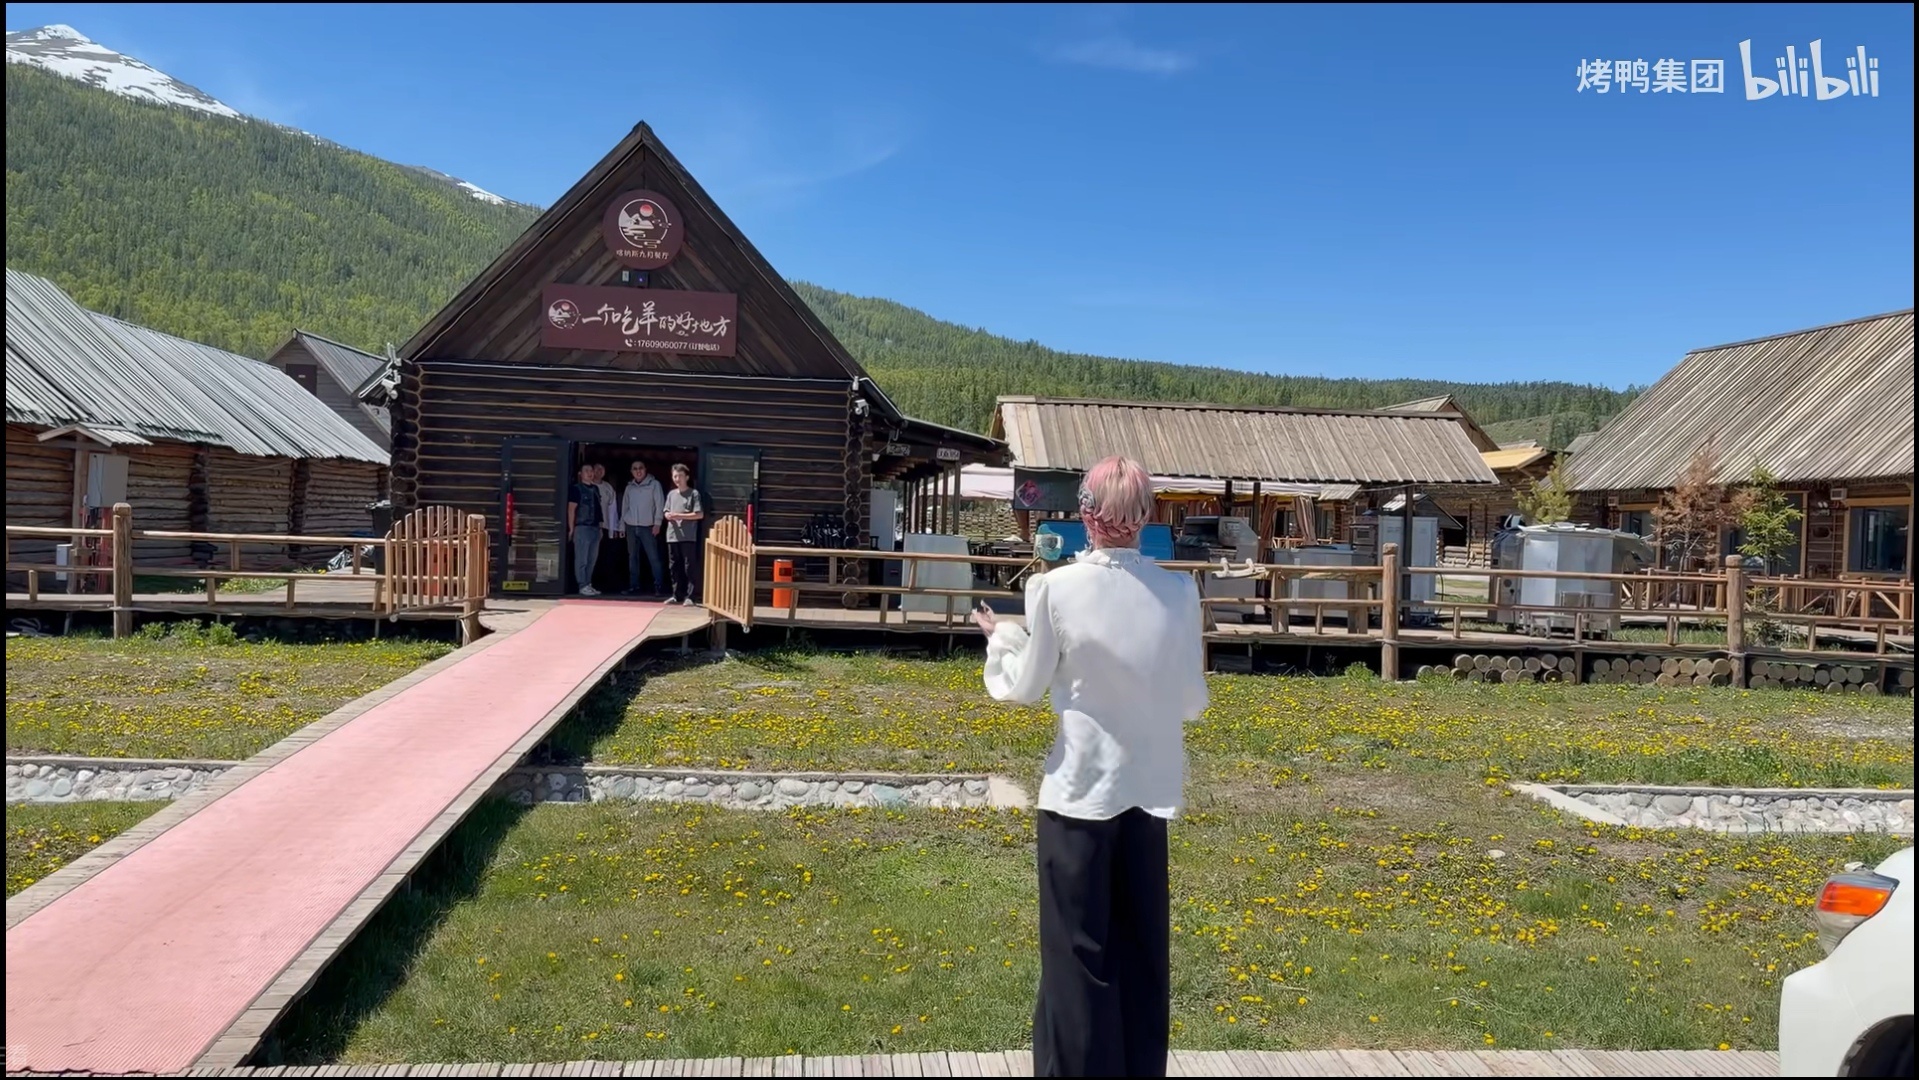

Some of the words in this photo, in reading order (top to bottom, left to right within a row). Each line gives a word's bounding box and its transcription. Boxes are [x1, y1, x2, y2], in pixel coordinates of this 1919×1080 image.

[582, 301, 731, 337] 一个吃羊的好地方
